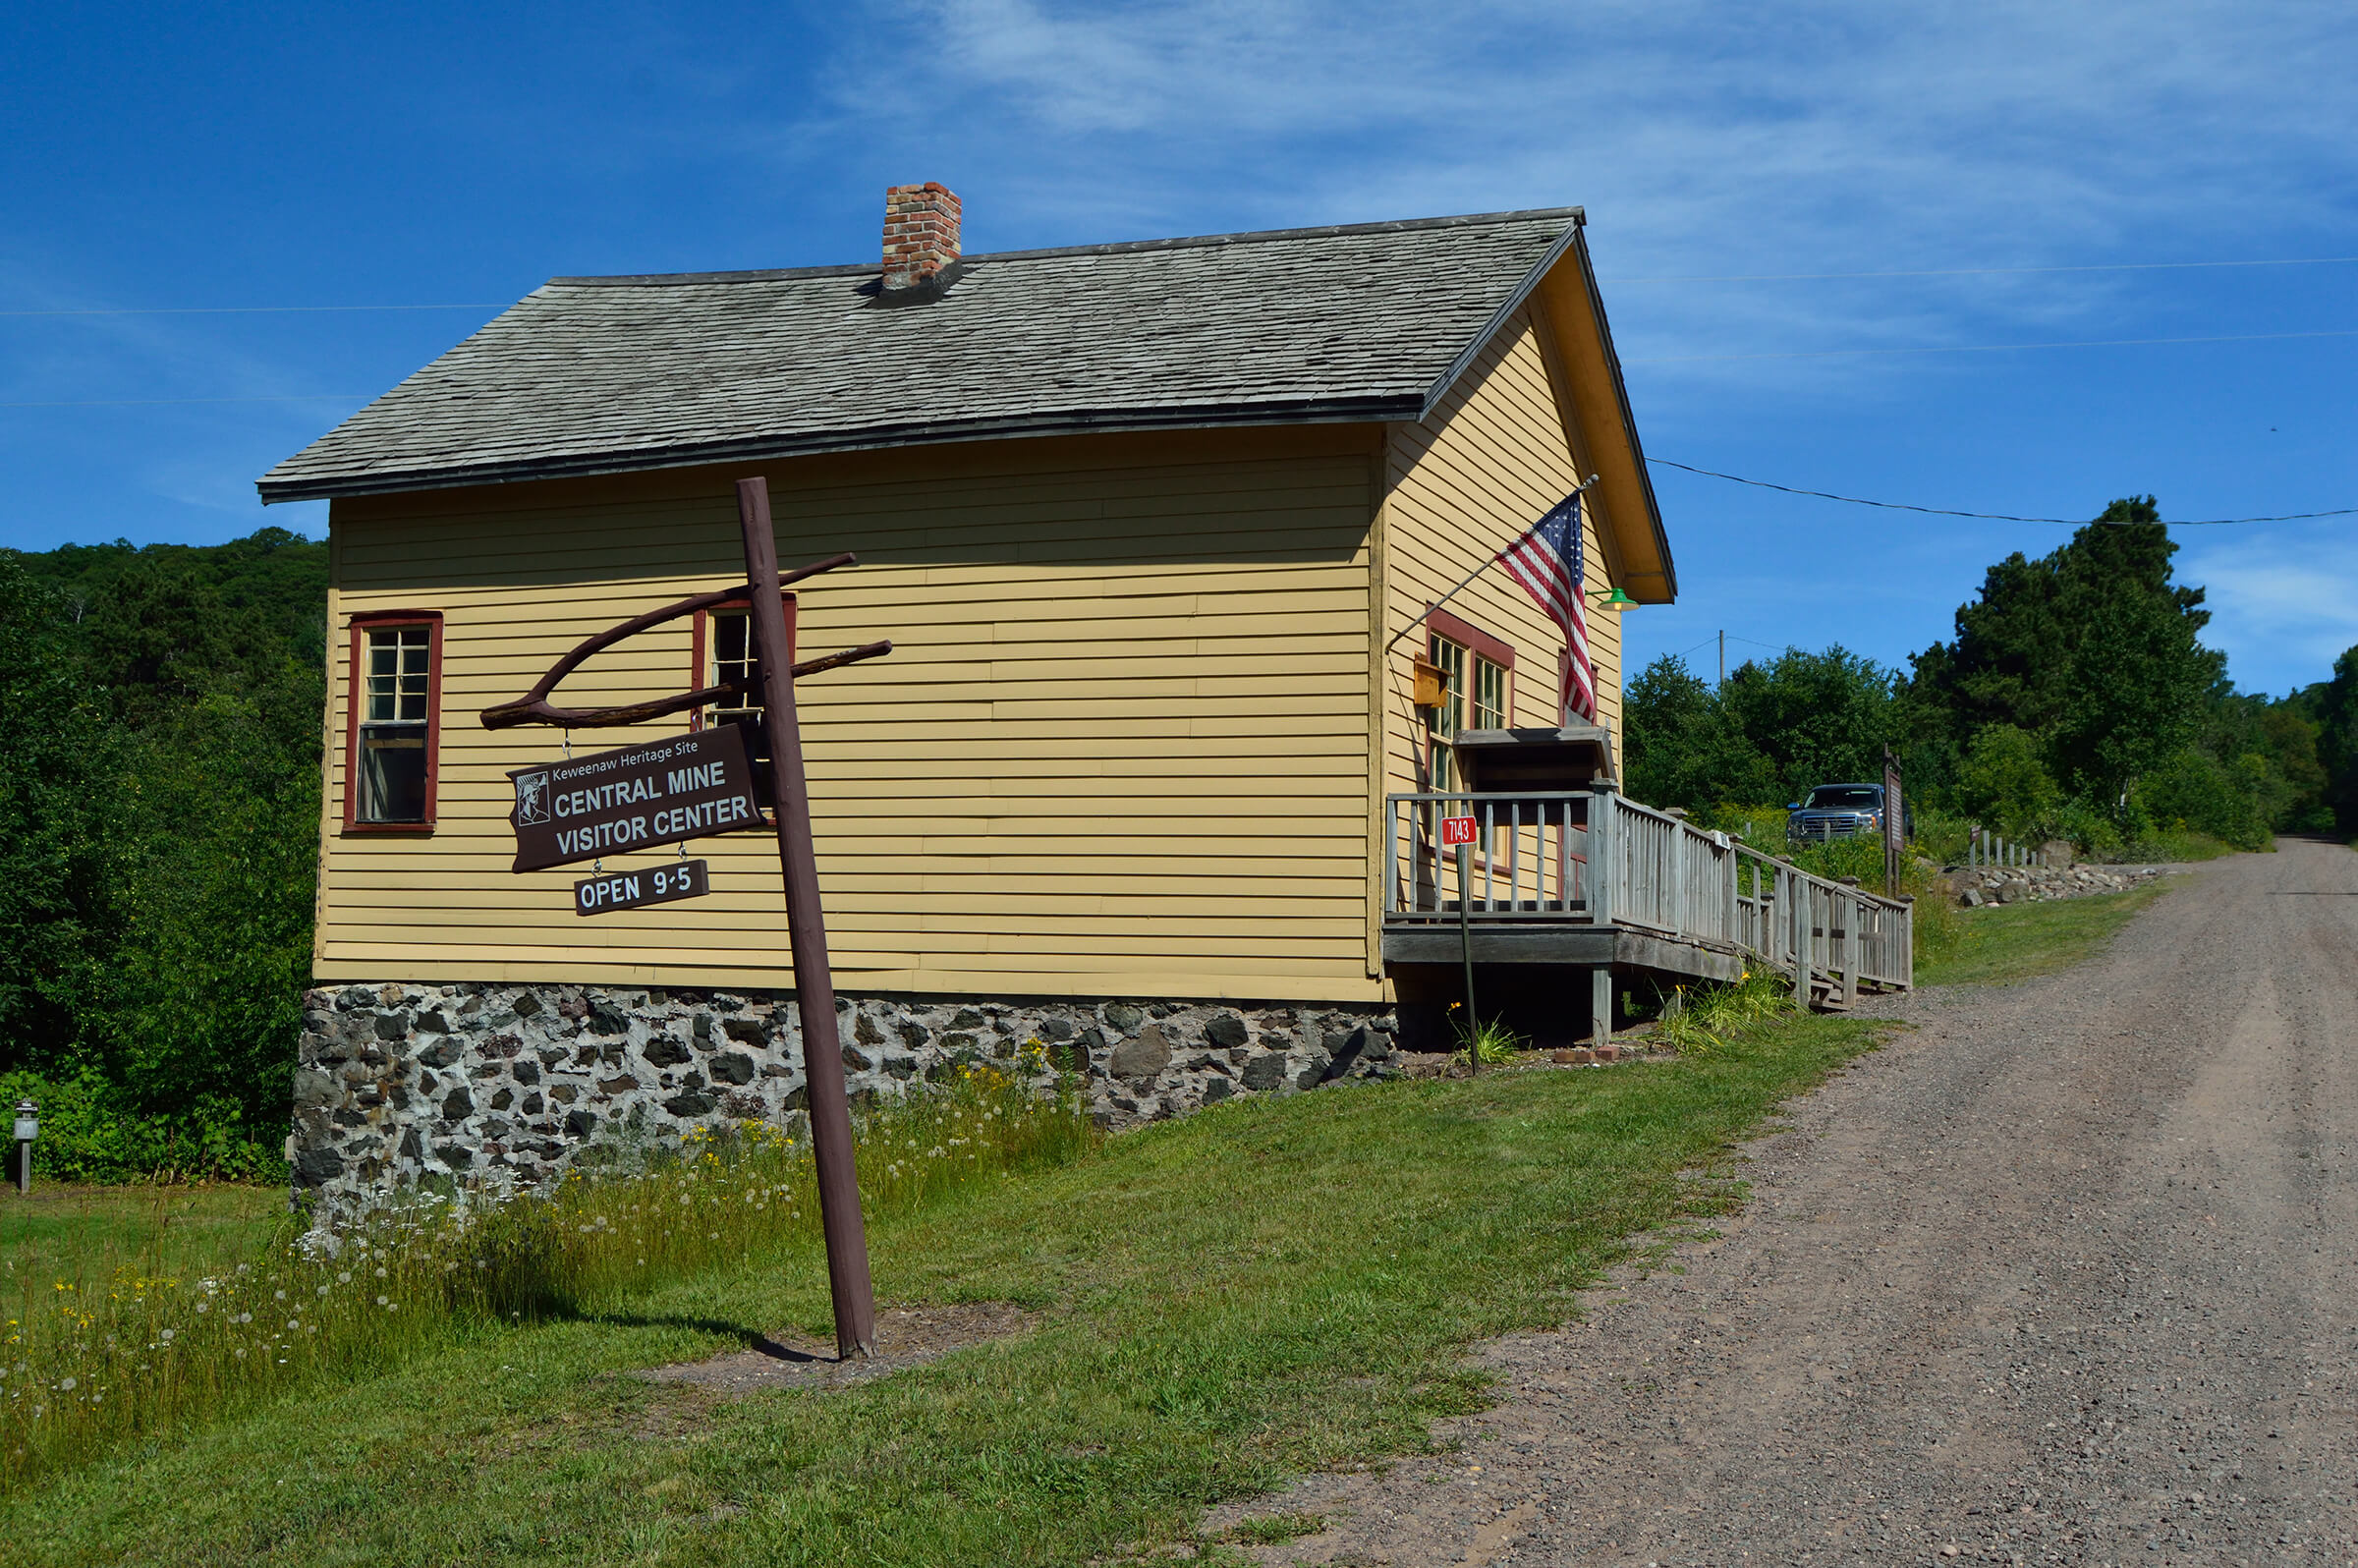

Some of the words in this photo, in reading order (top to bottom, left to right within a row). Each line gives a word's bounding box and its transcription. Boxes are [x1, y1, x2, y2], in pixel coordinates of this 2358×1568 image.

[553, 759, 617, 781] Keweenaw
[621, 747, 672, 767] Heritage
[675, 742, 699, 756] Site
[554, 776, 662, 817] CENTRAL
[667, 761, 726, 795] MINE
[556, 816, 648, 855] VISITOR
[653, 796, 749, 835] CENTER
[1449, 820, 1469, 841] 7143
[581, 875, 640, 908] OPEN
[653, 868, 691, 894] 9-5
